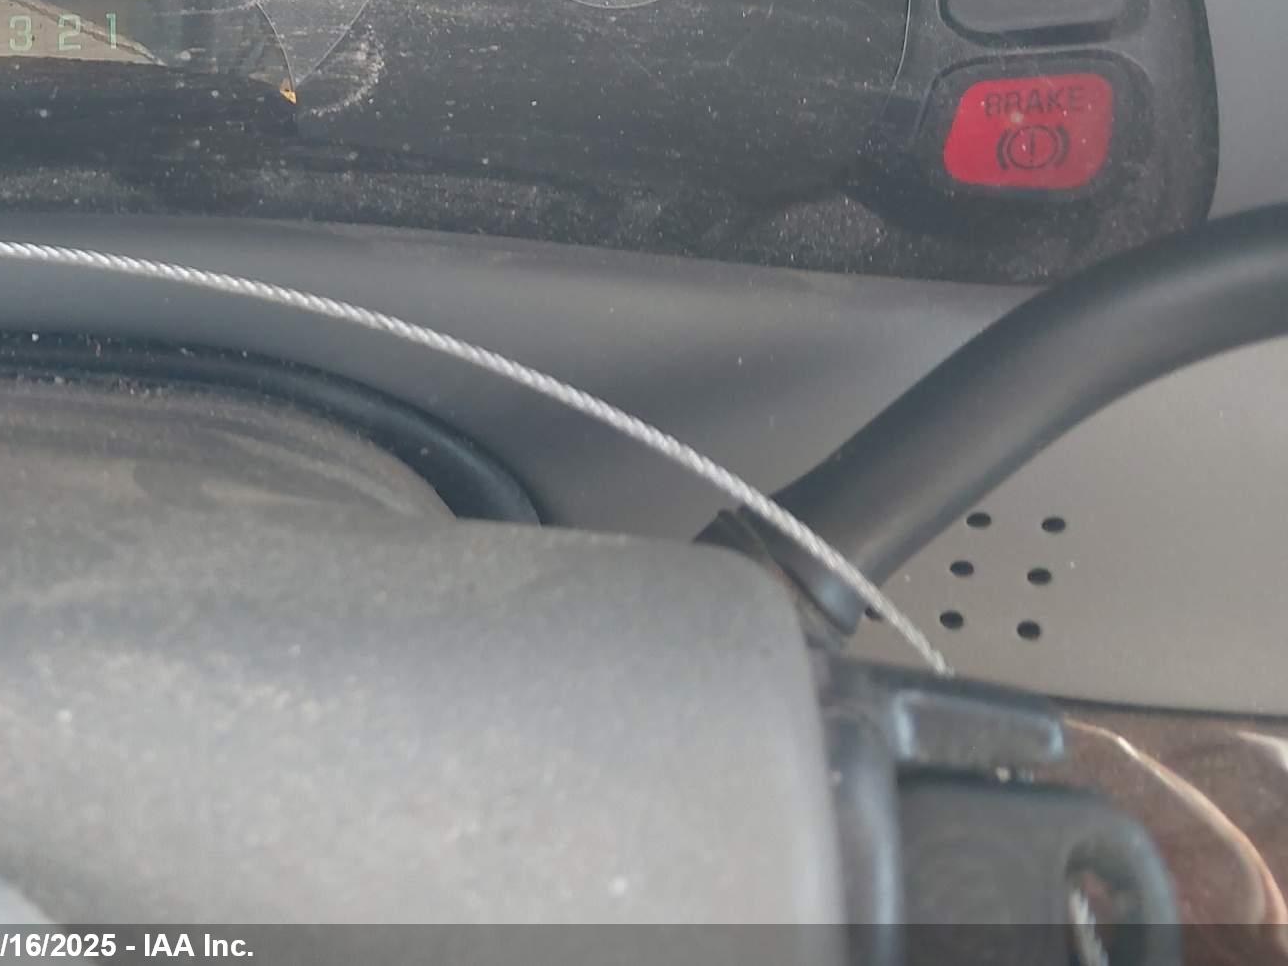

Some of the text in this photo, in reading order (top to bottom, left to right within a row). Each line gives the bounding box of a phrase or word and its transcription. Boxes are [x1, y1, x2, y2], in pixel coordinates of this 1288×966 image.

[10, 15, 33, 51] 3
[57, 13, 82, 51] 2
[106, 12, 118, 50] 1
[984, 85, 1086, 117] BRAKE
